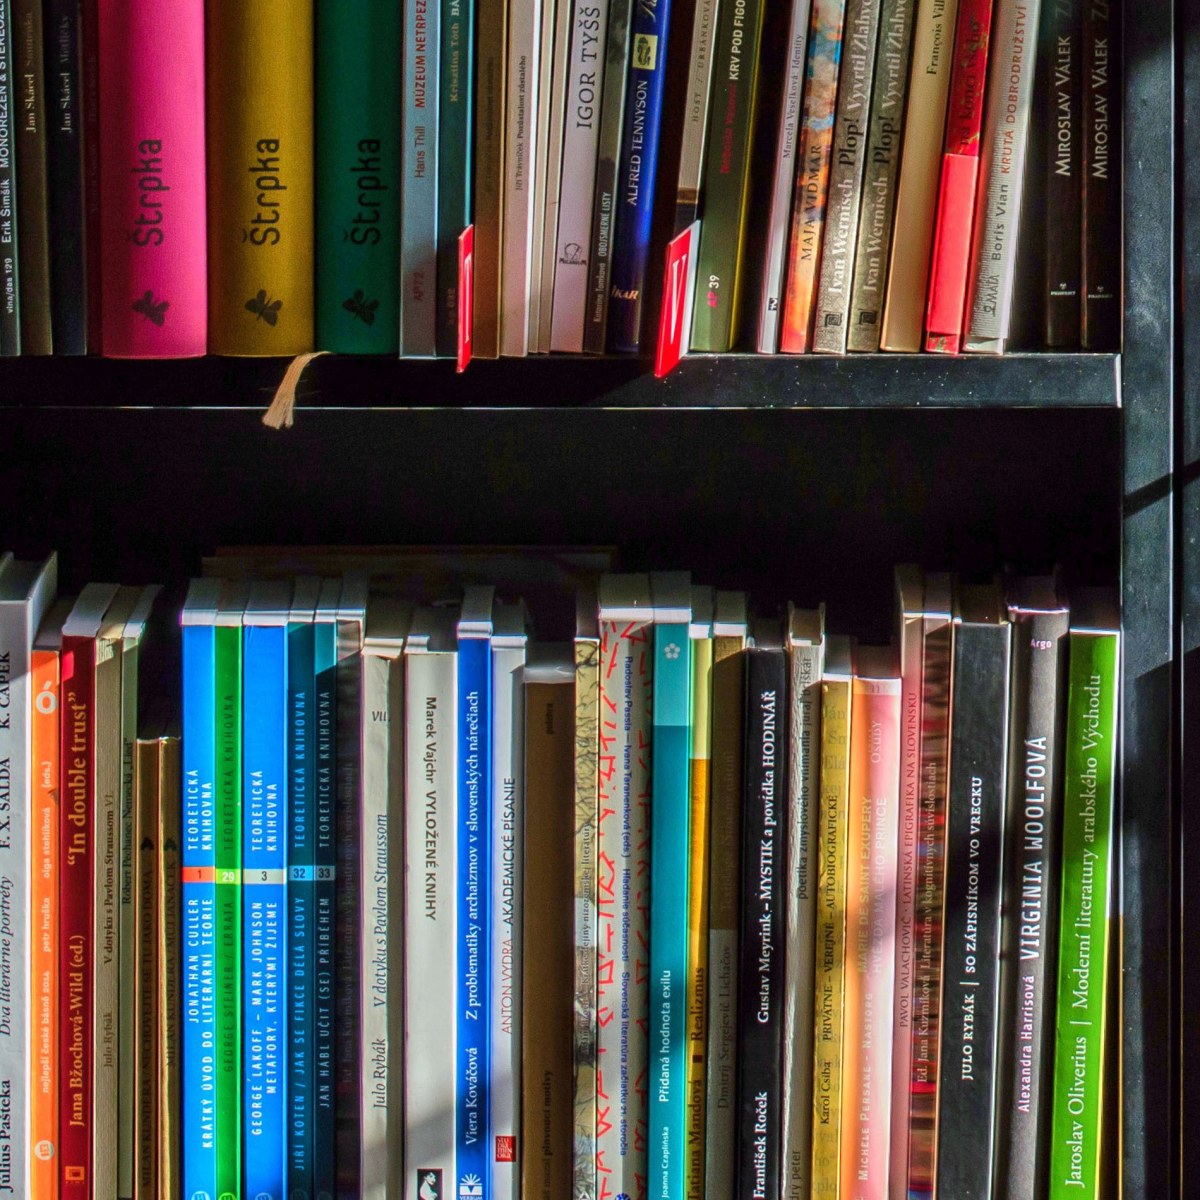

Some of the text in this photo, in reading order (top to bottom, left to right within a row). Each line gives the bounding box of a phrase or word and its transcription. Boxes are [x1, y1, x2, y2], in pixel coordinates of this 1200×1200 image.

[578, 6, 601, 63] TYŠŠ
[729, 56, 742, 80] KRV
[731, 29, 744, 52] POD
[925, 22, 946, 75] François
[414, 56, 427, 109] MÚZEUM
[575, 71, 597, 129] IGOR
[627, 80, 648, 205] ALFRED TENNYSON
[127, 139, 169, 247] Štrpka
[241, 138, 286, 247] Štrpka
[343, 138, 387, 247] Štrpka
[827, 117, 863, 293] Ivan Wernisch Plop!
[466, 692, 480, 752] nárečiach
[67, 759, 87, 825] double
[466, 757, 482, 831] slovenských
[466, 846, 480, 919] archaizmov
[1021, 737, 1047, 960] VIRGINIA WOOLFOVÁ
[69, 934, 86, 968] (ed.)
[188, 898, 200, 1023] JONATHAN CULLER
[465, 923, 482, 1007] problematiky
[961, 777, 982, 1080] JULO RYBÁK SO ZÁPISNÍKOM VO VRECKU
[1064, 674, 1103, 1188] Jaroslav Oliverius Moderní literatury arabského Východu
[67, 972, 85, 1088] Bžochová-Wild
[69, 1093, 85, 1127] Jana
[464, 1047, 479, 1108] Kováčová
[465, 1112, 479, 1145] Viera
